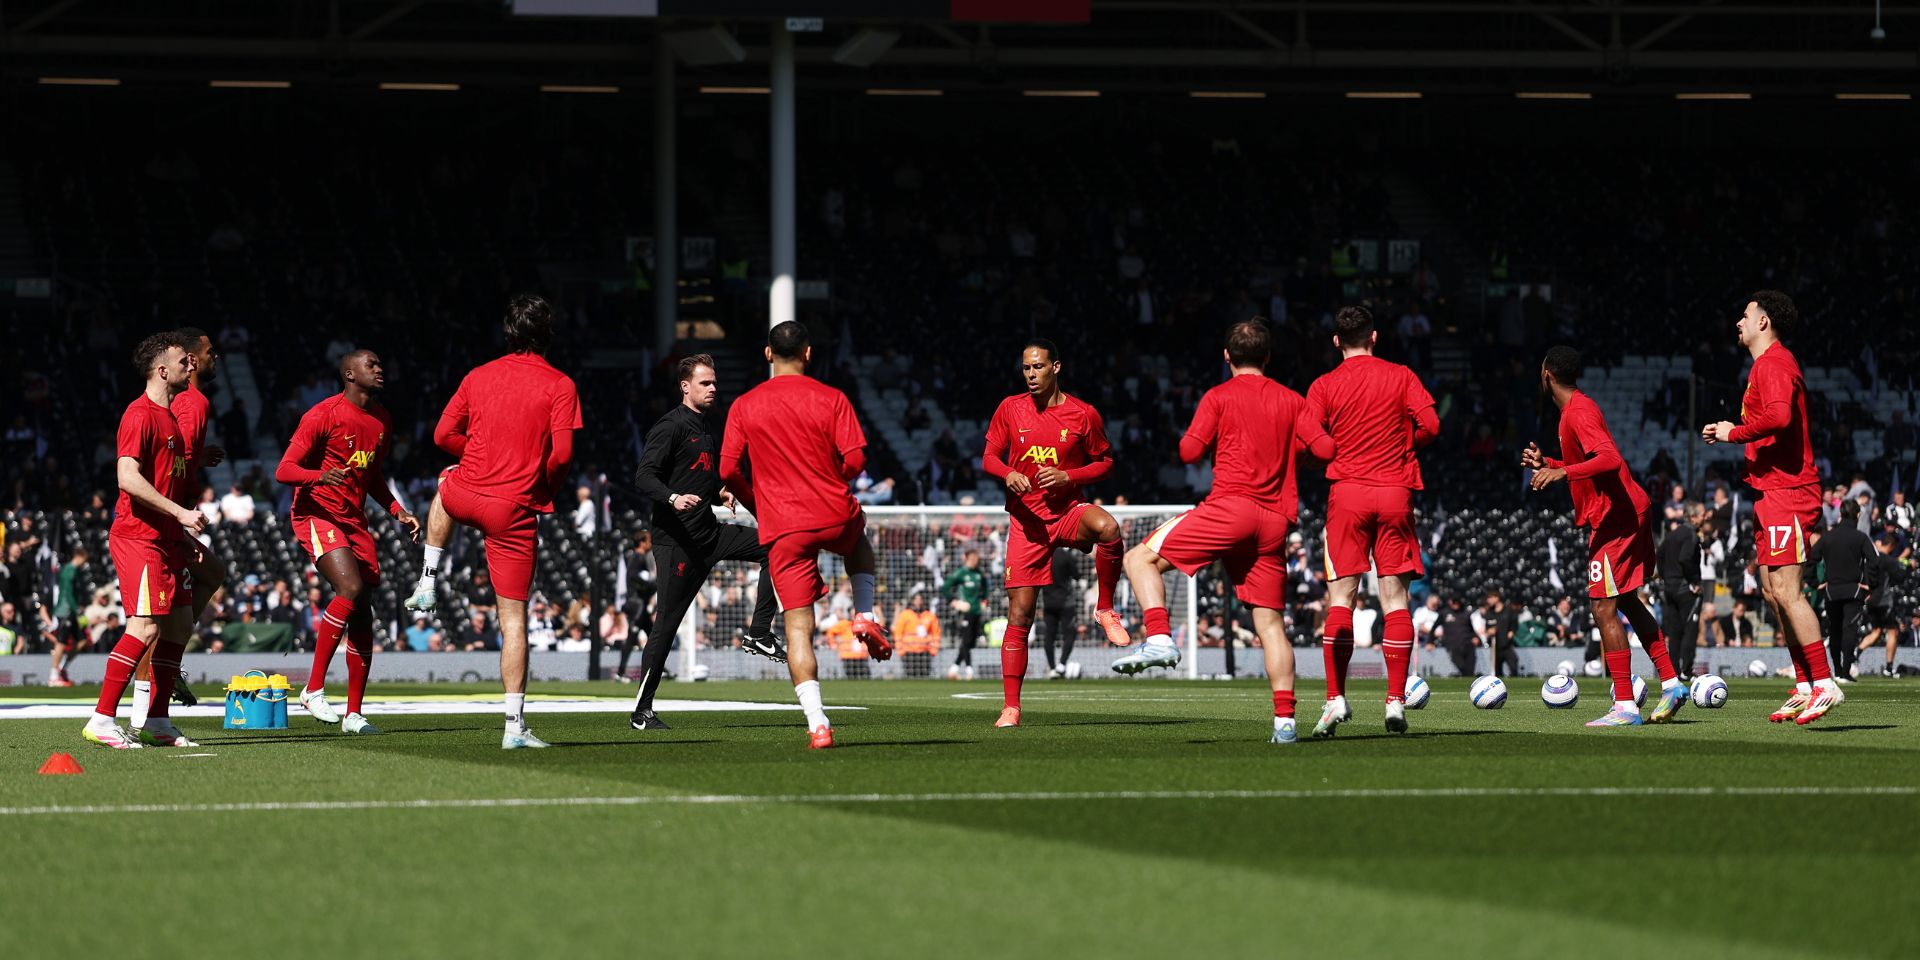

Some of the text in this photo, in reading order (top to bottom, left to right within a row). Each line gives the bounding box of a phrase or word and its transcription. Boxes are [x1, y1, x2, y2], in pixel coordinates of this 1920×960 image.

[348, 440, 353, 448] 5
[346, 450, 375, 468] AXA
[1020, 445, 1059, 465] AXA
[167, 455, 186, 479] AXA
[1768, 525, 1792, 549] 17
[1588, 560, 1603, 582] 8
